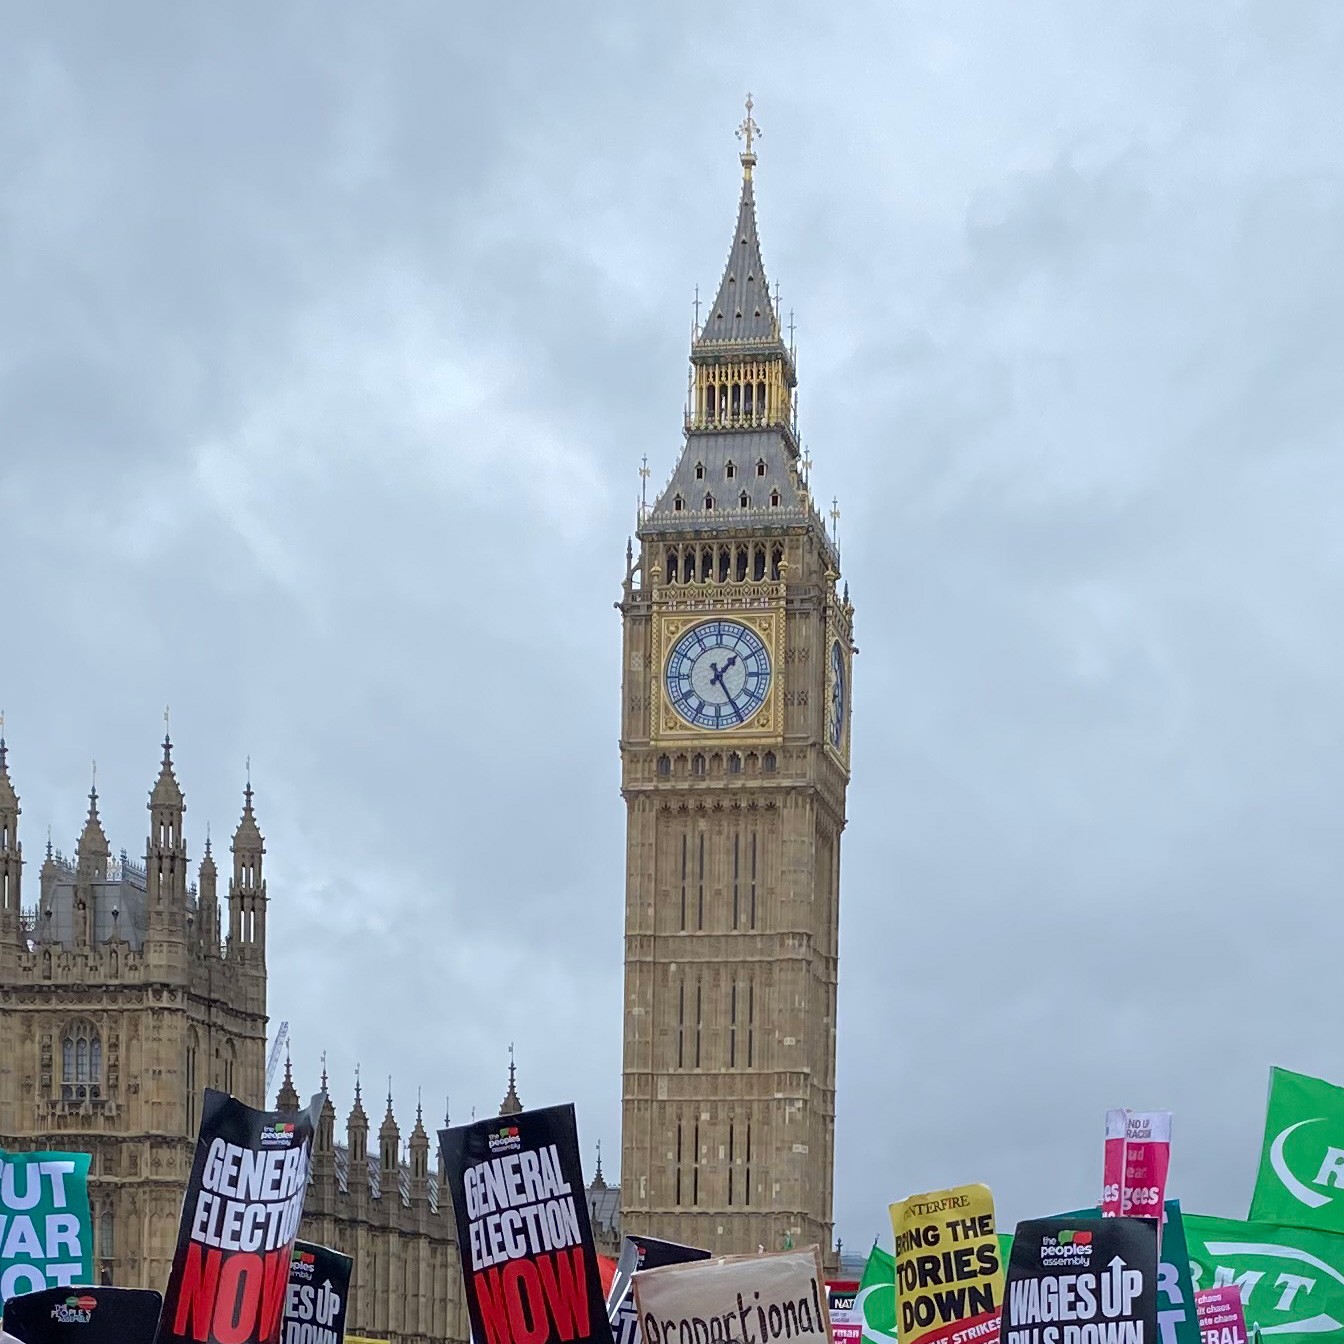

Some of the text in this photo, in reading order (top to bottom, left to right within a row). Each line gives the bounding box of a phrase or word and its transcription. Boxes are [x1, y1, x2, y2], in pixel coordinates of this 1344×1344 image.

[464, 1144, 572, 1221] GENERAL
[469, 1196, 582, 1272] ELECTION
[895, 1214, 994, 1257] BRING THE
[1041, 1244, 1092, 1258] peoples
[1043, 1236, 1057, 1245] the
[896, 1244, 999, 1296] TORIES
[1043, 1257, 1090, 1267] assembly
[317, 1279, 340, 1326] UP
[902, 1283, 996, 1333] DOWN
[1010, 1273, 1097, 1326] WAGES
[1101, 1256, 1143, 1318] UP
